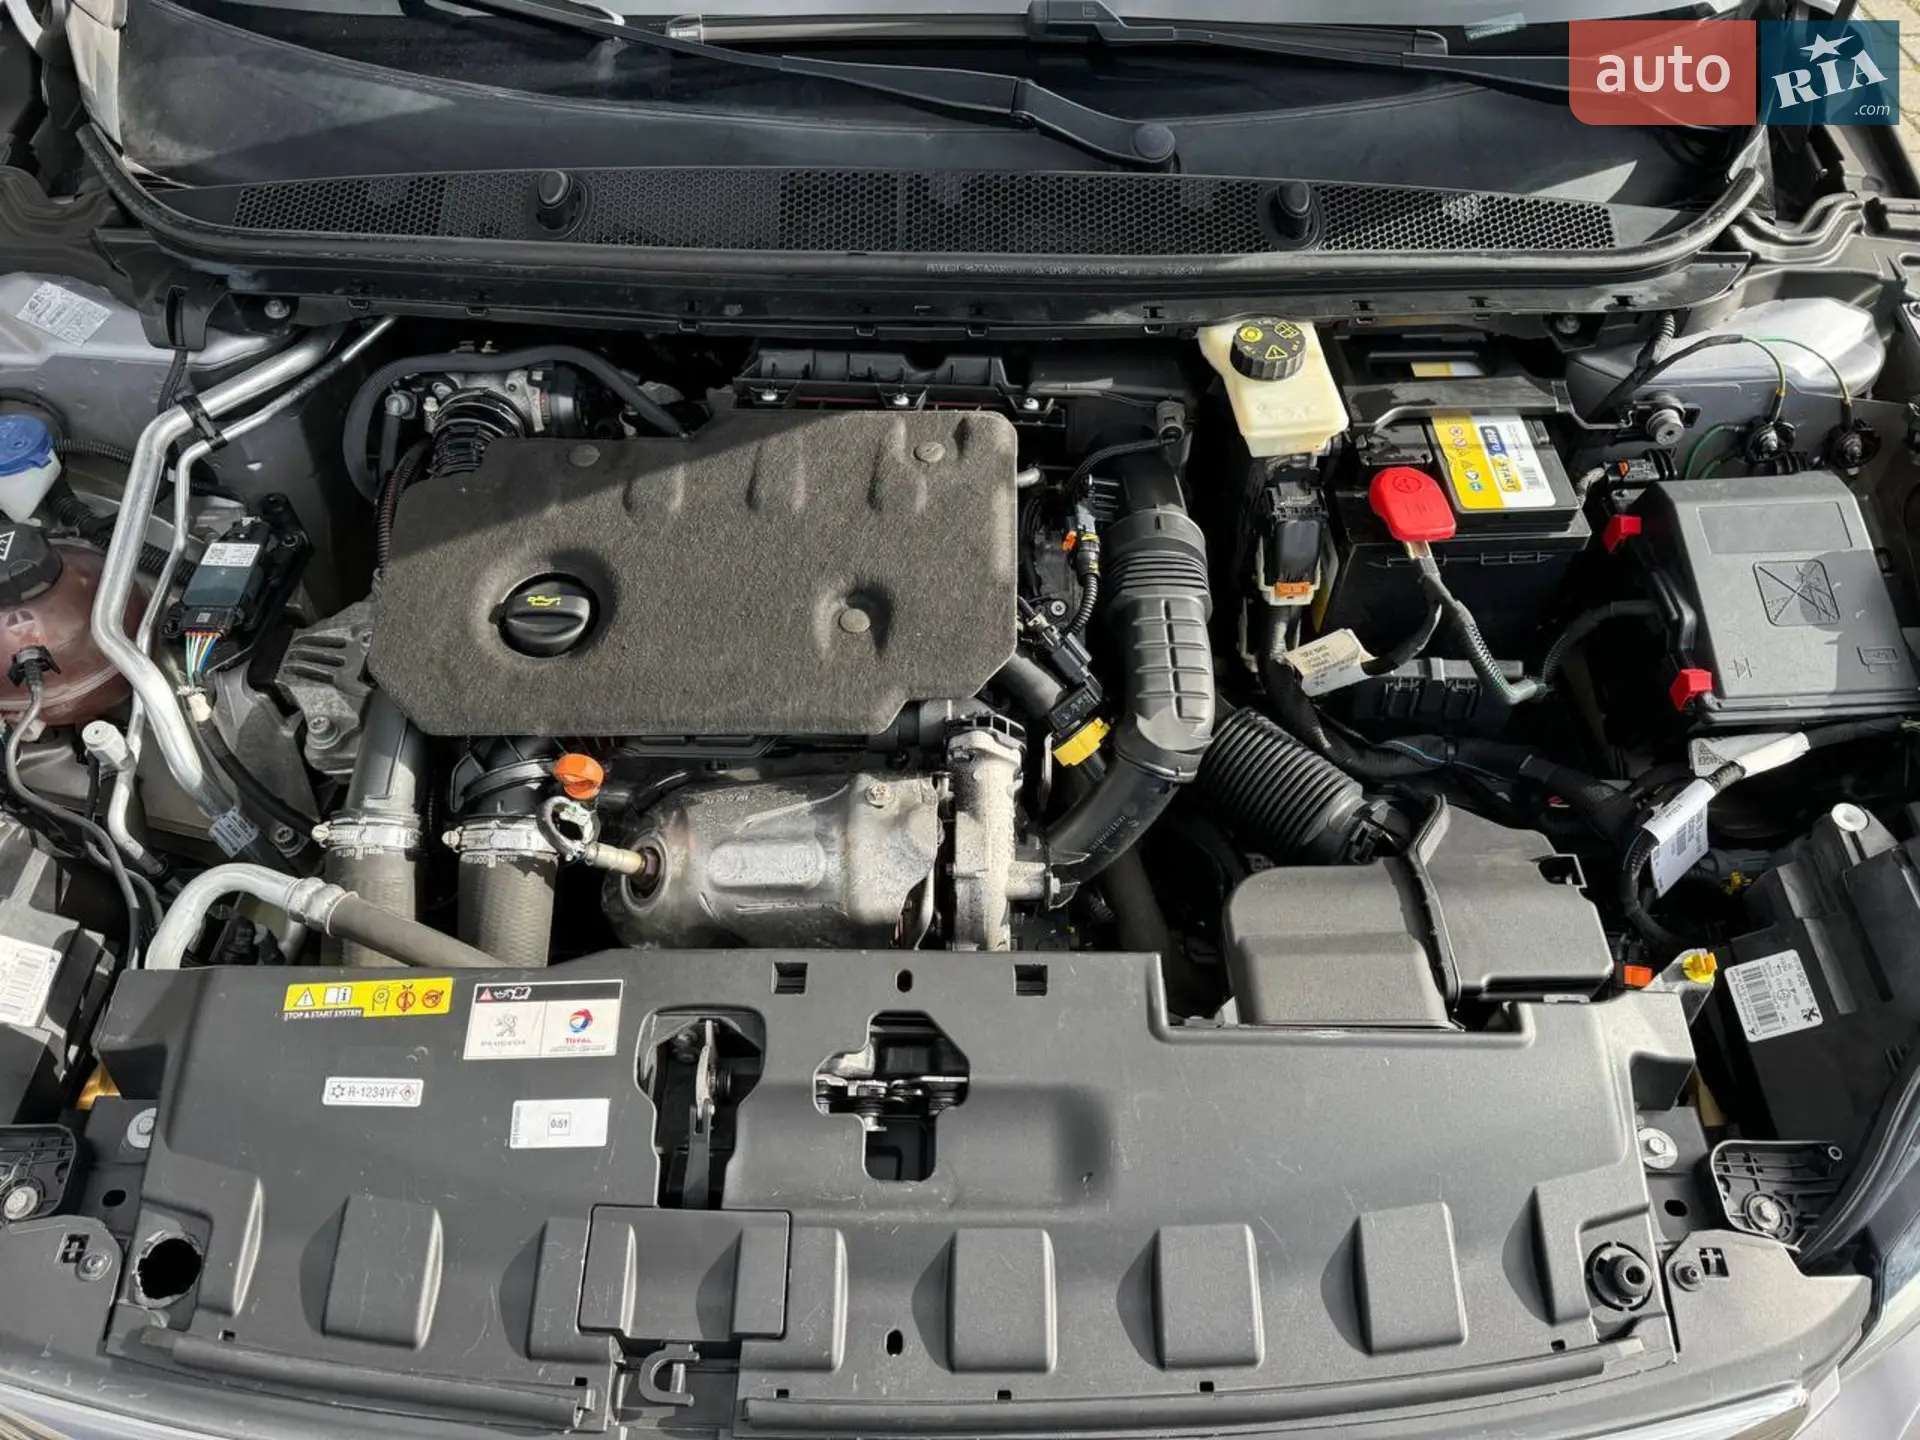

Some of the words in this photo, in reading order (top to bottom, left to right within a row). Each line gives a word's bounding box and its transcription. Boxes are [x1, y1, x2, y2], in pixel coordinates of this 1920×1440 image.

[284, 1011, 303, 1021] STOP
[311, 1010, 333, 1018] START
[334, 1009, 362, 1017] SYSTEM
[565, 1037, 593, 1045] TOTAL
